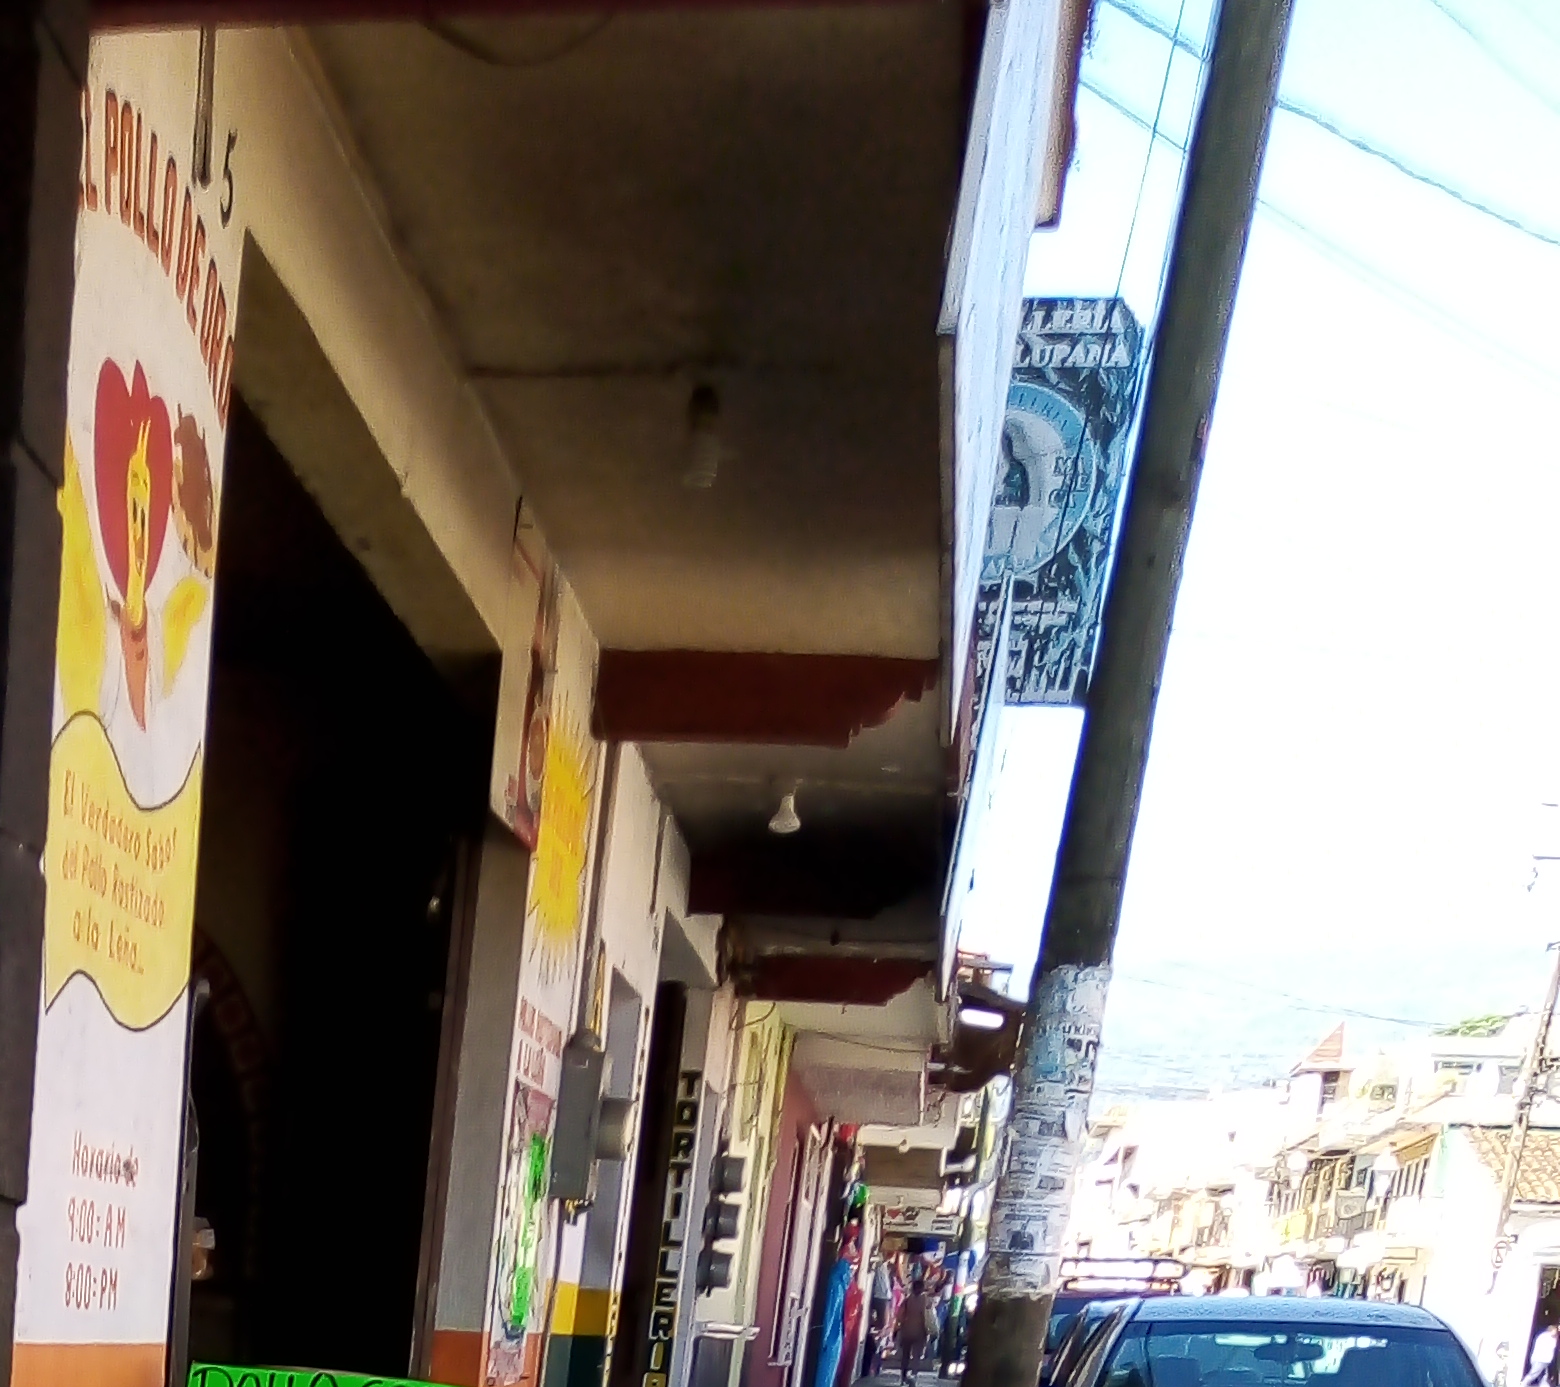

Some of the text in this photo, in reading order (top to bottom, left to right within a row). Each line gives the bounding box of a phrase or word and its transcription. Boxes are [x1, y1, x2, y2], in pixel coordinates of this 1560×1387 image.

[104, 87, 178, 277] POLLO
[176, 186, 206, 336] DE
[63, 767, 178, 874] El Verdadero Sabor
[61, 839, 78, 881] del
[81, 843, 108, 898] Pollo
[72, 908, 82, 942] a
[86, 906, 100, 952] la
[72, 1129, 122, 1185] Horario
[99, 1266, 119, 1311] PM
